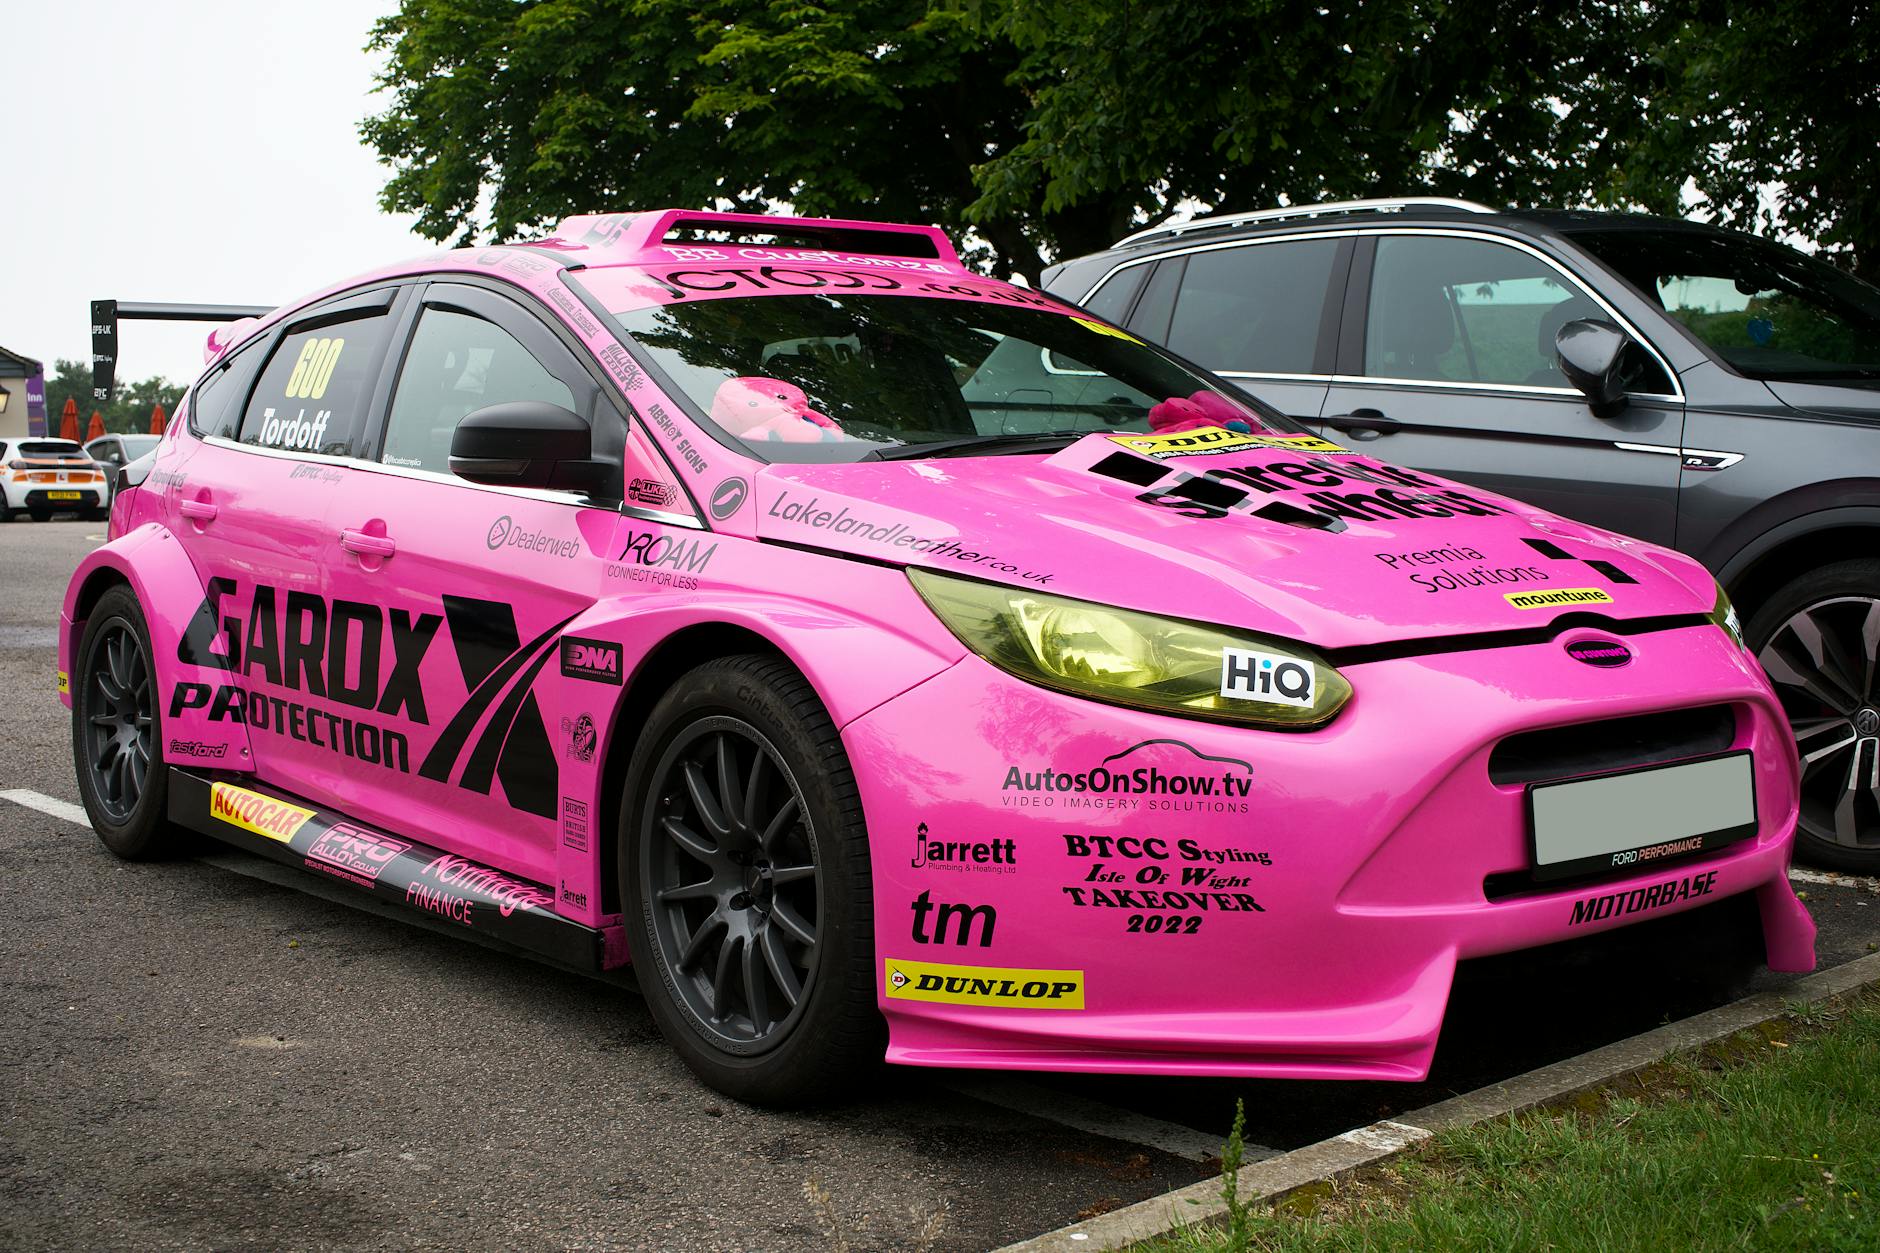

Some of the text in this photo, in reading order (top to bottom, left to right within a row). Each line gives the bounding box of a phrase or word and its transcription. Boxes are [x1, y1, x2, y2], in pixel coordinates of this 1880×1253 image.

[661, 247, 730, 262] BB
[285, 338, 345, 400] 600
[258, 407, 332, 450] Tordoff
[676, 438, 709, 475] SIGNS
[507, 526, 580, 559] Dealerweb
[768, 490, 1055, 585] Lakelandleather.co.uk
[1374, 543, 1488, 570] Premia
[607, 564, 698, 591] CONNECT FOR LESS
[1409, 565, 1550, 593] Solutions
[1510, 590, 1608, 607] mountune
[177, 576, 445, 726] GARDX
[567, 643, 617, 672] DNA
[1227, 654, 1311, 702] HiQ
[168, 681, 410, 774] PROTECTION
[1002, 765, 1253, 798] AutosOnShow.tv
[213, 786, 305, 836] AUTOCAR
[1002, 796, 1250, 815] VIDEO IMAGERY SOLUTIONS
[312, 843, 379, 876] ALLOY.CO.UK
[320, 825, 402, 862] PRO
[911, 833, 1017, 869] jarrett
[1062, 833, 1274, 867] BTCC Styling
[1611, 836, 1703, 867] FORD PERFORMANCE
[928, 862, 1017, 875] Plumbing & Heating Ltd
[1084, 863, 1253, 889] Isle Of Wight
[406, 880, 475, 926] FINANCE
[1062, 886, 1267, 913] TAKEOVER
[1568, 870, 1719, 926] MOTORBASE
[910, 887, 998, 948] tm
[1125, 914, 1204, 935] 2022
[914, 973, 1078, 999] DUNLOP
